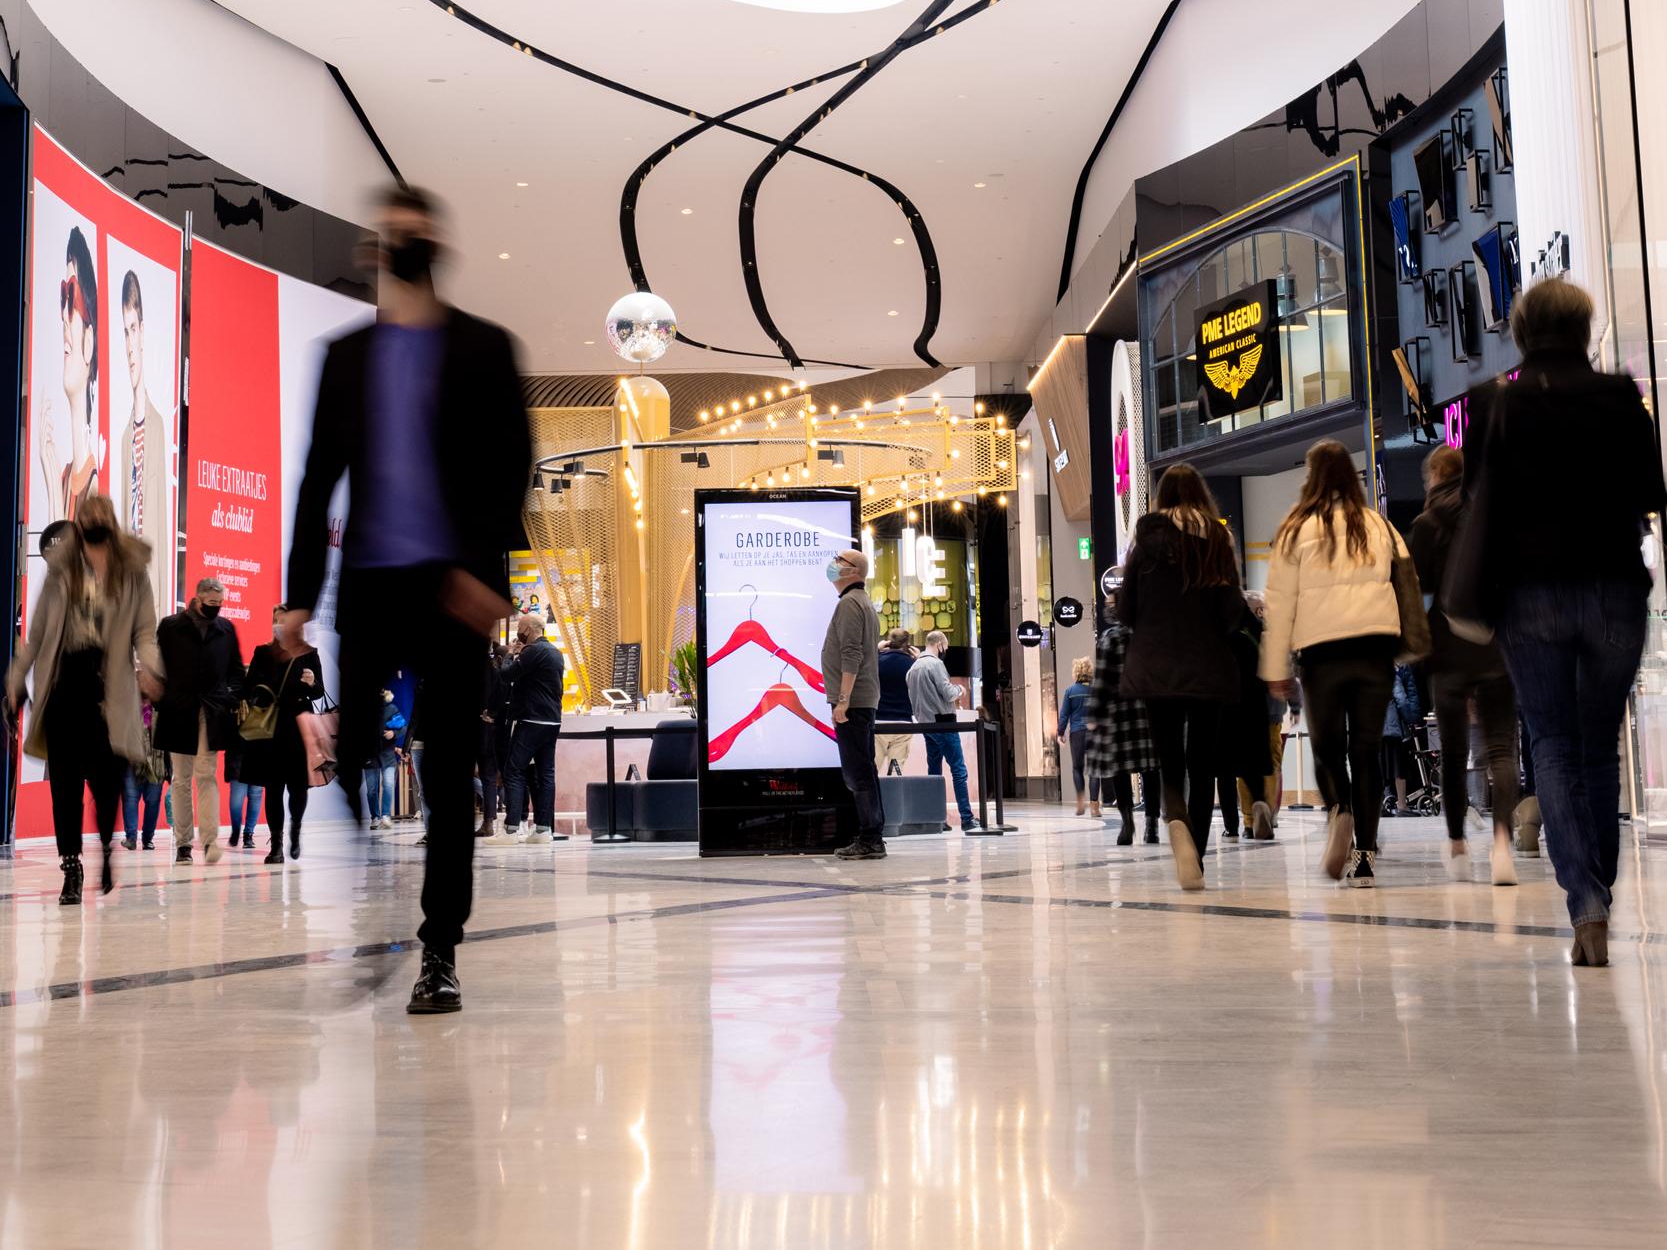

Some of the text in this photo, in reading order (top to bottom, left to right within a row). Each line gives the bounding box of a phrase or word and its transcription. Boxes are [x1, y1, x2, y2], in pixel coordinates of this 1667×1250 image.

[1202, 302, 1262, 344] PME LEGEND
[1209, 333, 1257, 359] AMERICAN CLASSIC
[198, 459, 267, 501] LEUKE EXTRAATJES
[211, 502, 253, 533] als clublid
[736, 531, 820, 548] GARDEROBE
[719, 551, 729, 560] WIJ
[731, 551, 752, 559] LETTEN
[754, 551, 761, 559] OP
[763, 551, 770, 559] JE
[808, 550, 838, 558] AANKOPEN
[754, 559, 766, 567] AAN
[808, 558, 822, 566] BENT
